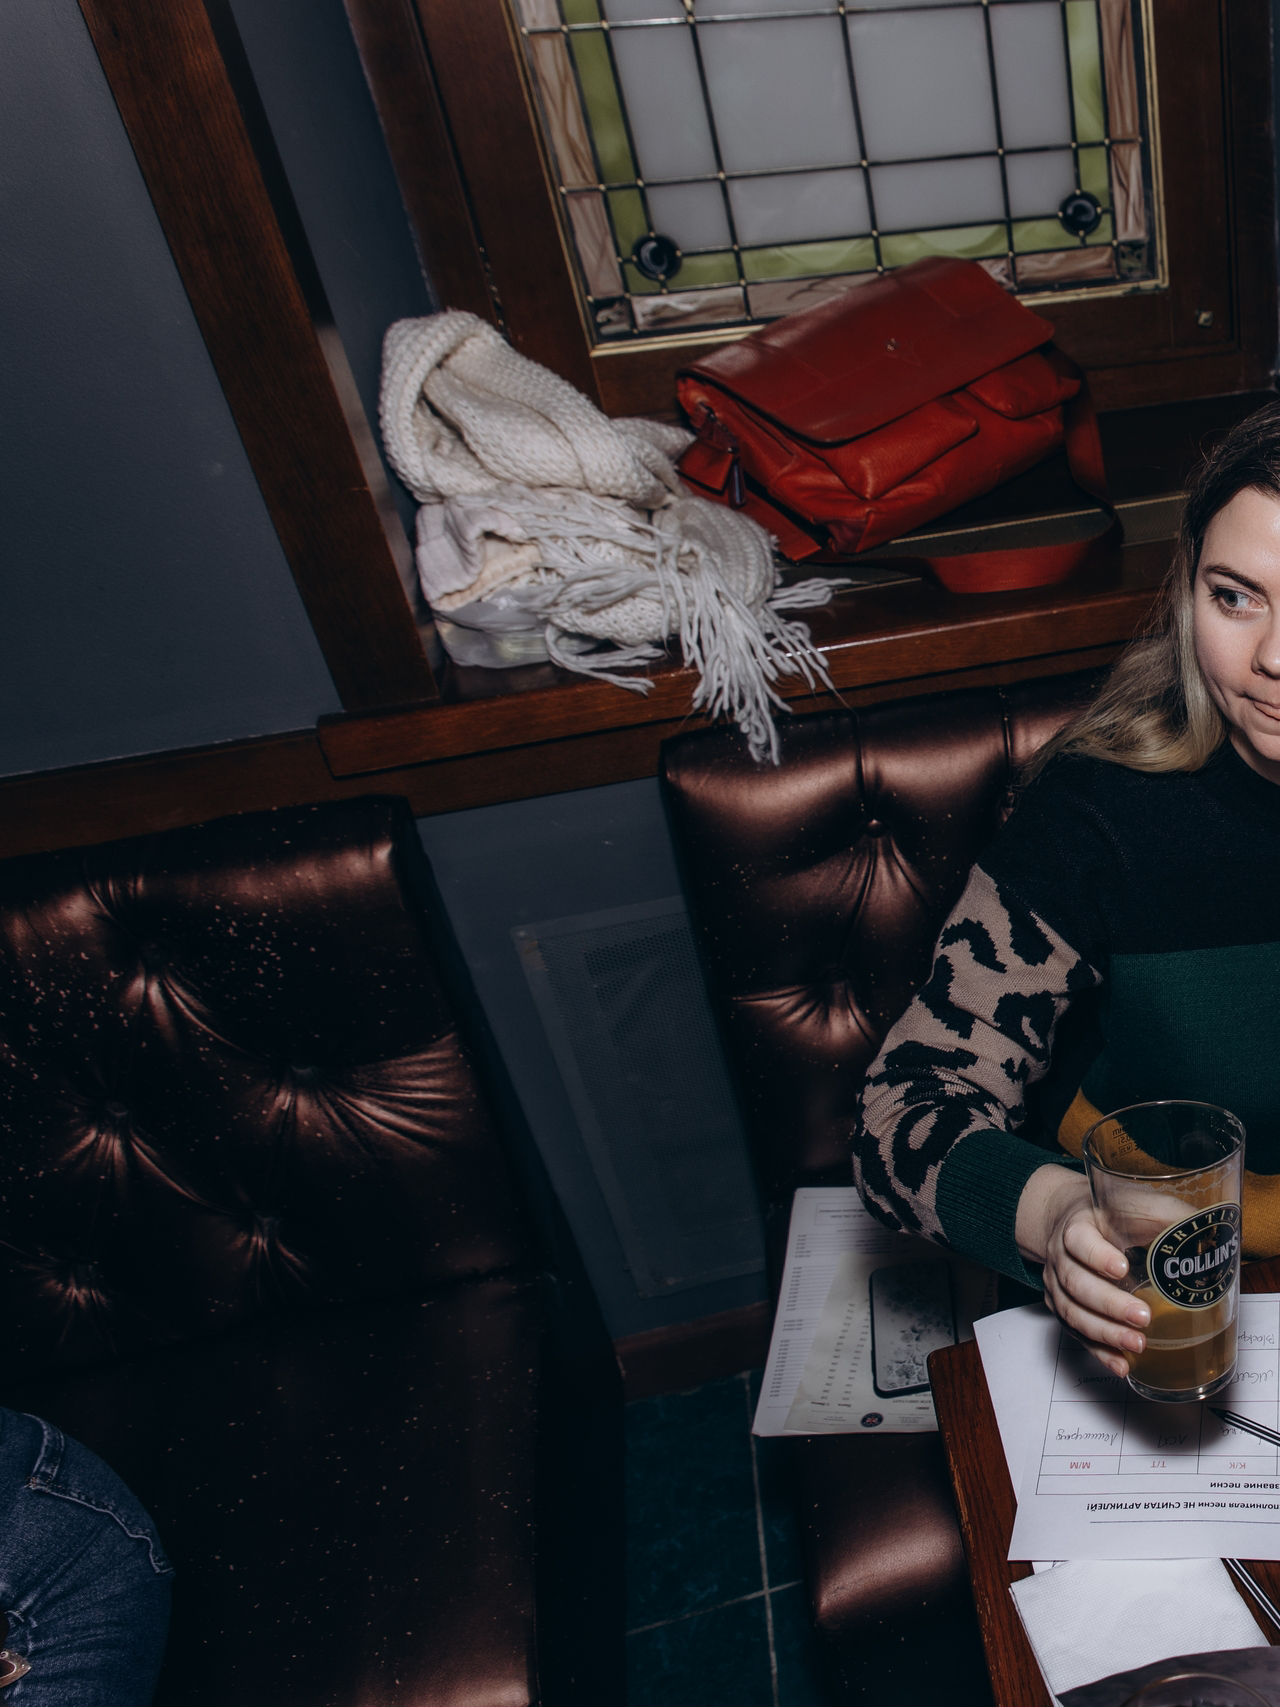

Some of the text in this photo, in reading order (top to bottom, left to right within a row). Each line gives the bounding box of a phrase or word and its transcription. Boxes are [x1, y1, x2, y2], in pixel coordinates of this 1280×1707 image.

[1164, 1231, 1239, 1279] COLLIN'S
[1171, 1264, 1235, 1303] STOUT
[1210, 1482, 1241, 1490] песни
[1086, 1502, 1142, 1512] АРТИКЛЕЙ!
[1144, 1502, 1181, 1510] СЧИТАЯ
[1198, 1501, 1227, 1509] песни
